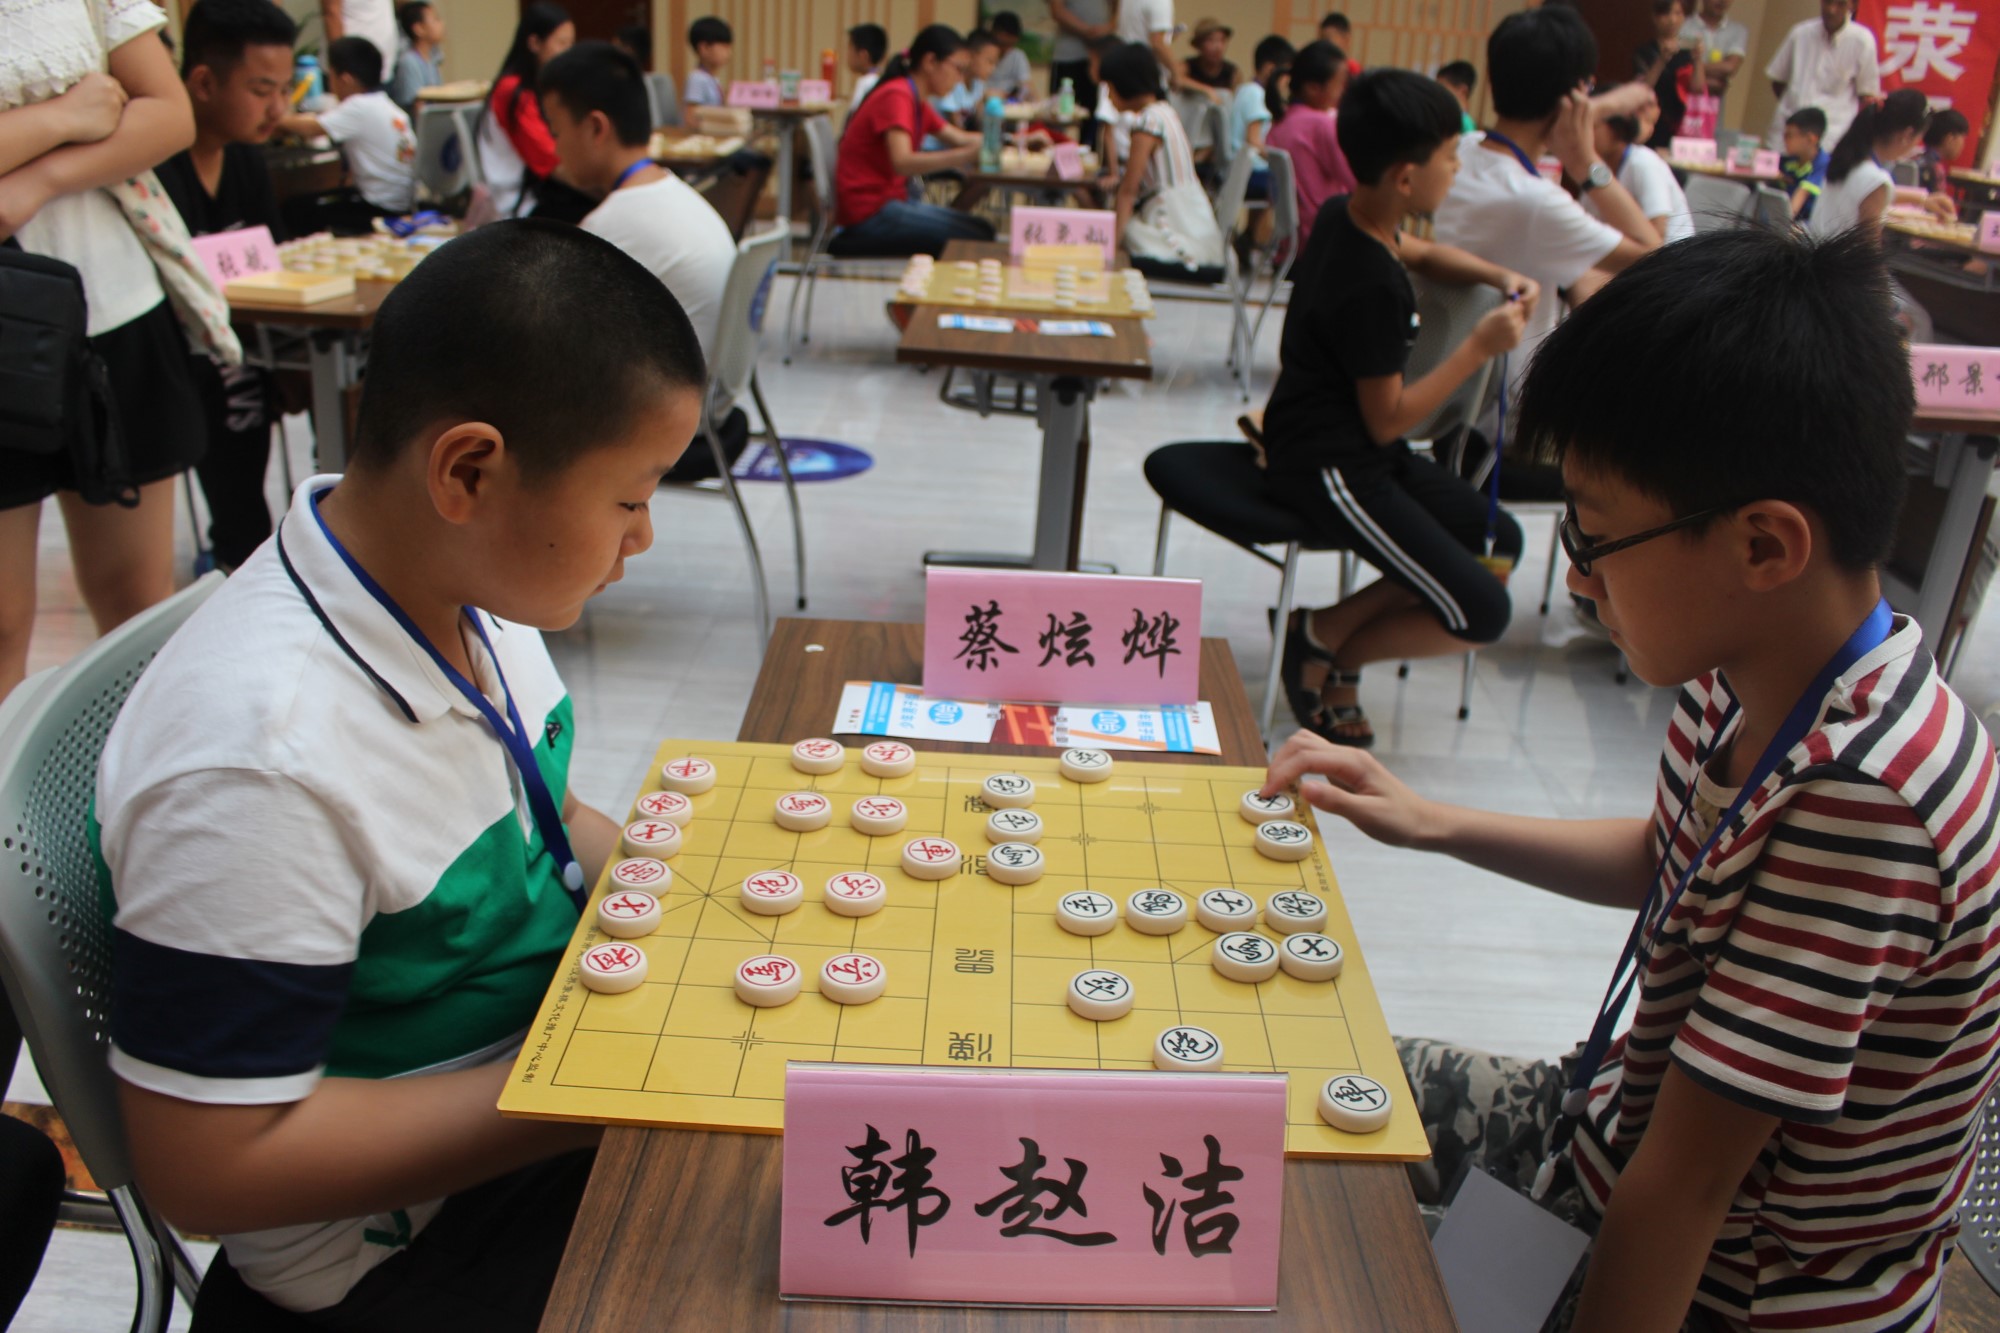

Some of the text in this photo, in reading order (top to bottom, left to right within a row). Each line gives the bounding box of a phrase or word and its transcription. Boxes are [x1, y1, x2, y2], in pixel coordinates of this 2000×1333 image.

[1879, 1, 1978, 113] 荥
[1921, 361, 2000, 397] 邢景
[953, 599, 1183, 679] 蔡炫烨
[823, 1123, 1245, 1259] 韩赵洁
